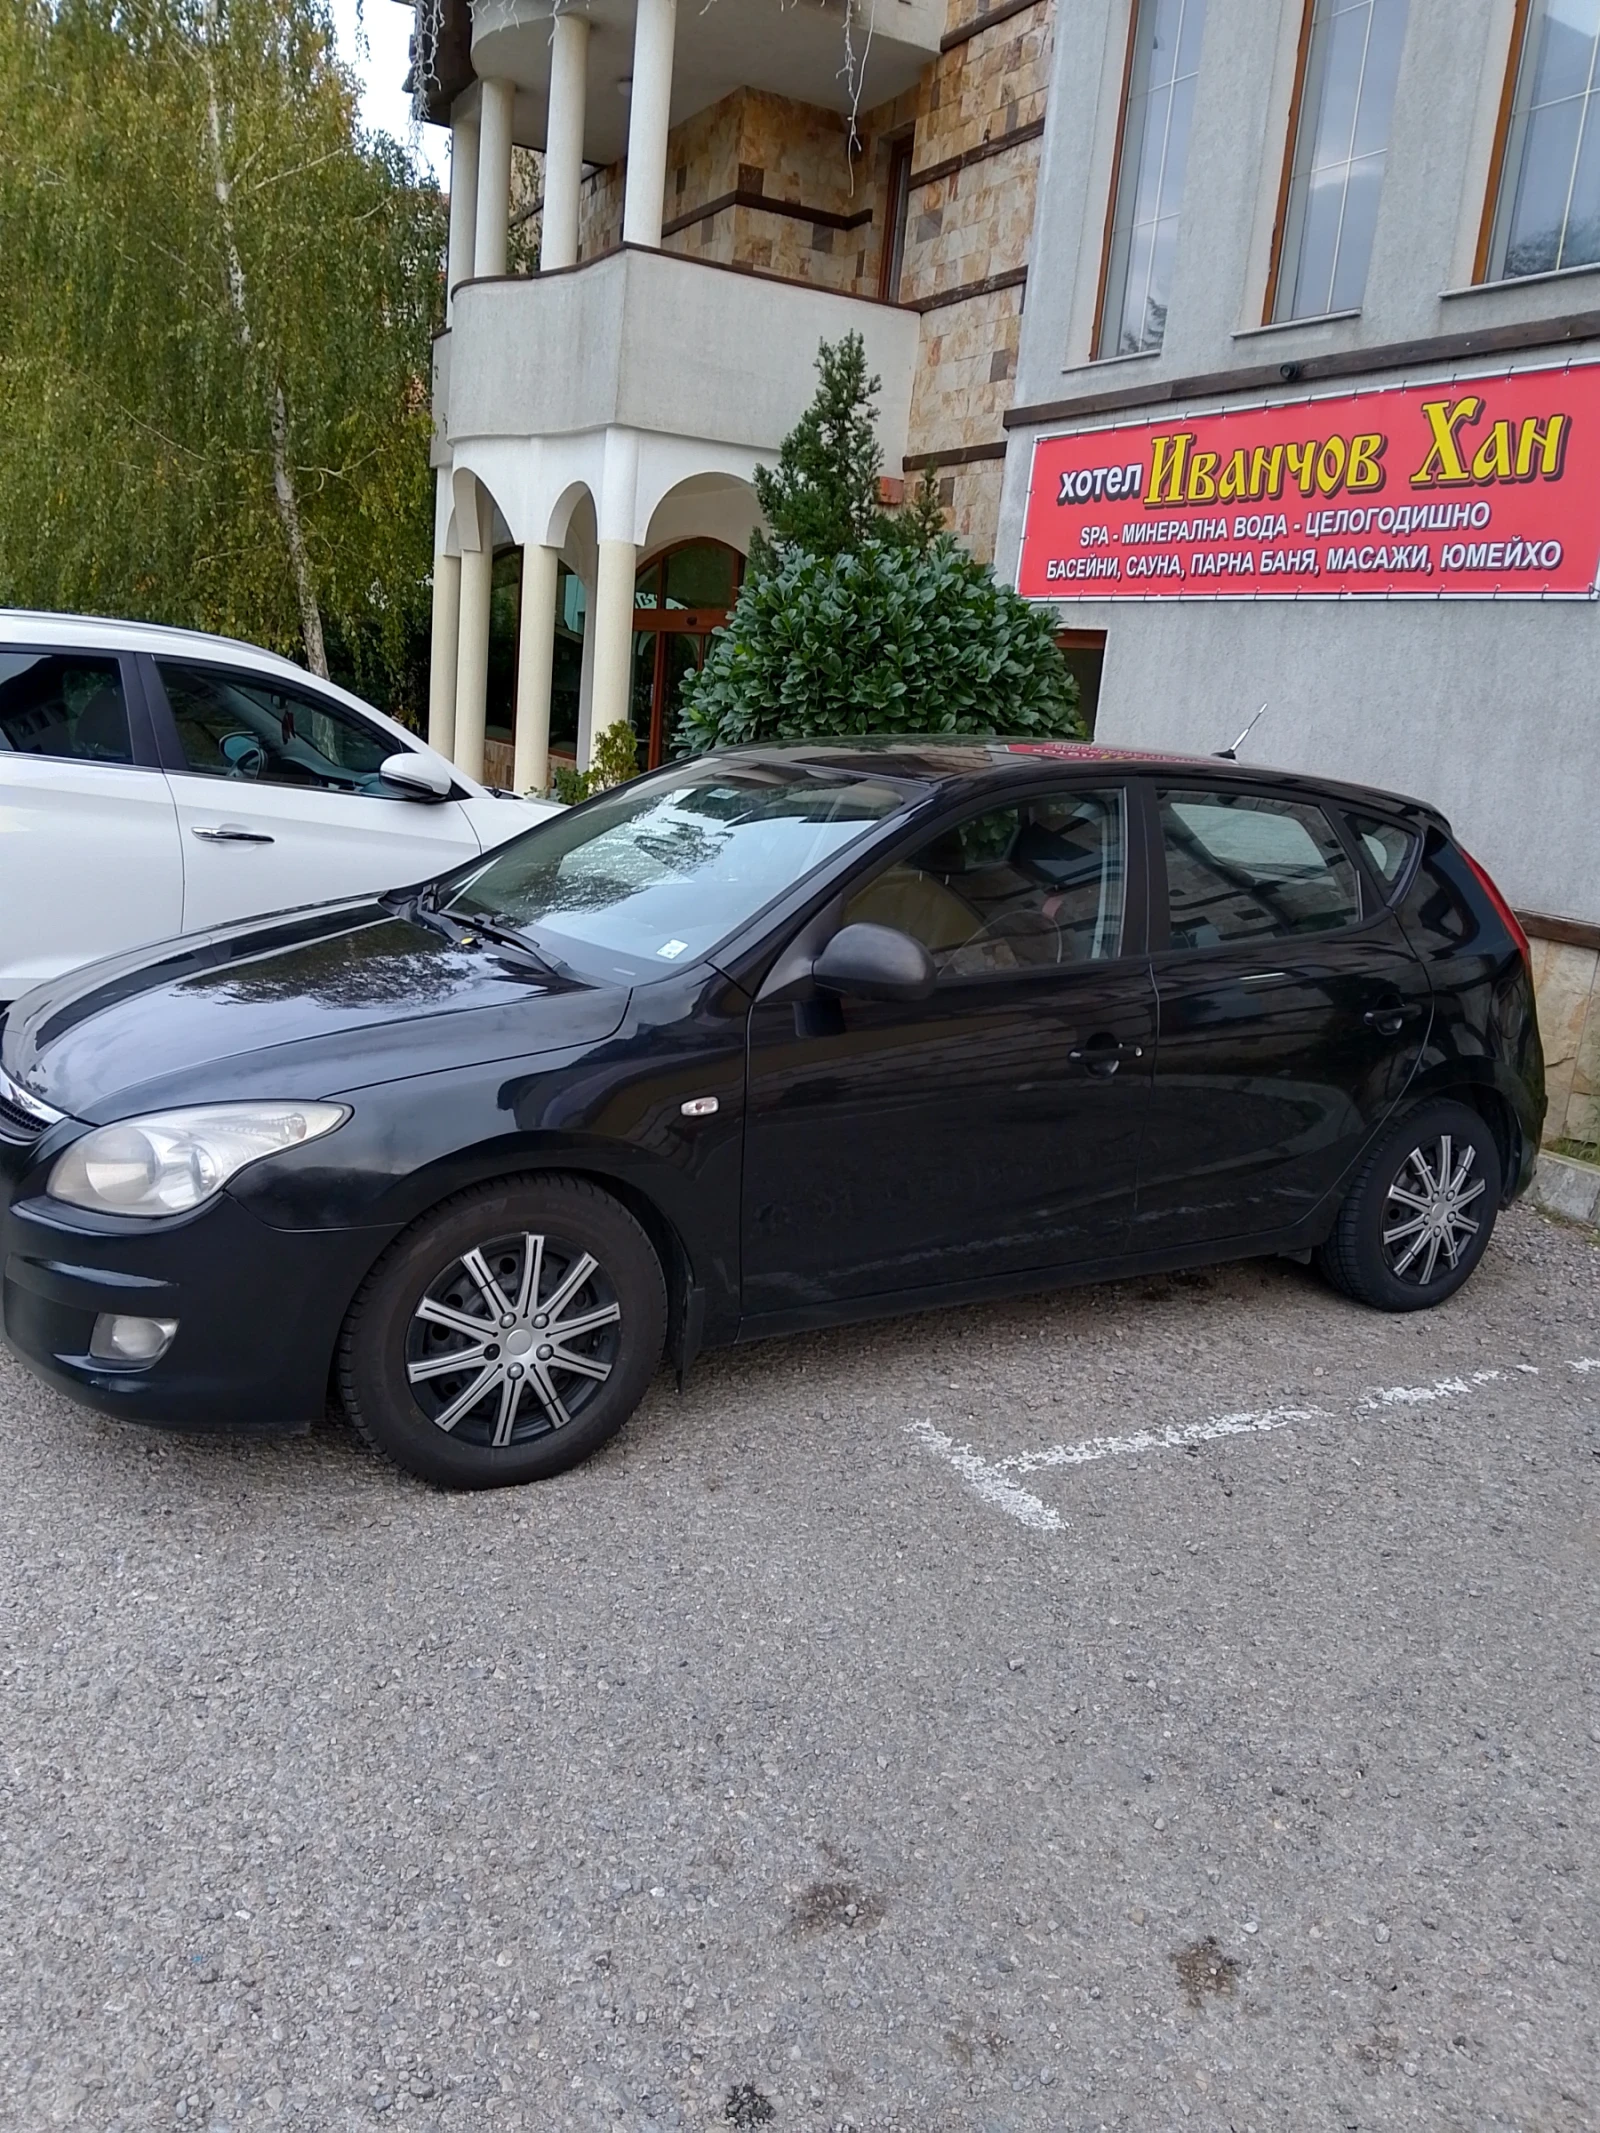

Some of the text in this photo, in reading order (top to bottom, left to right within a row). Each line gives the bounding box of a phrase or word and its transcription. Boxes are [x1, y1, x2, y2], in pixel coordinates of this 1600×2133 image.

[1143, 433, 1387, 508] Иванчов
[1409, 396, 1573, 491] Хан
[1080, 526, 1110, 548] SPA
[1121, 518, 1229, 545] МИНЕРАЛНА
[1233, 513, 1288, 541] ВОДА
[1304, 502, 1491, 540] ЦЕЛОГОДИШНО
[1046, 535, 1565, 581] БАСЕЙНИ, САУНА, ПАРНА БАНЯ, МАСАЖИ, ЮМЕЙХО
